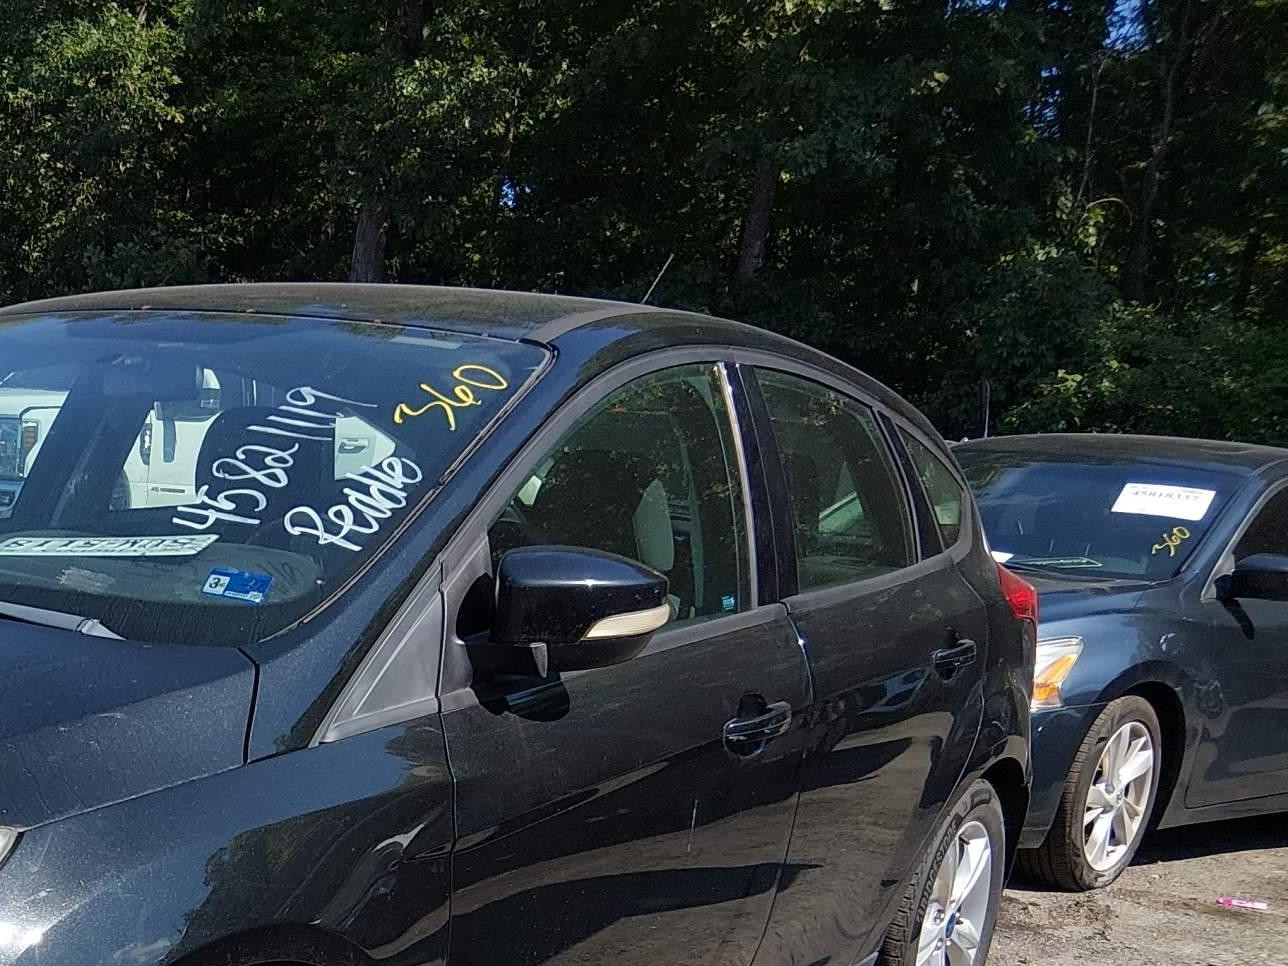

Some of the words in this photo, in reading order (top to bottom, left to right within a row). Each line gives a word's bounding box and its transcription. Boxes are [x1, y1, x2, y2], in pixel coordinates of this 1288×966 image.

[394, 365, 508, 431] 360
[172, 386, 378, 529] 45821119
[1152, 526, 1191, 557] 360
[209, 577, 221, 589] 3
